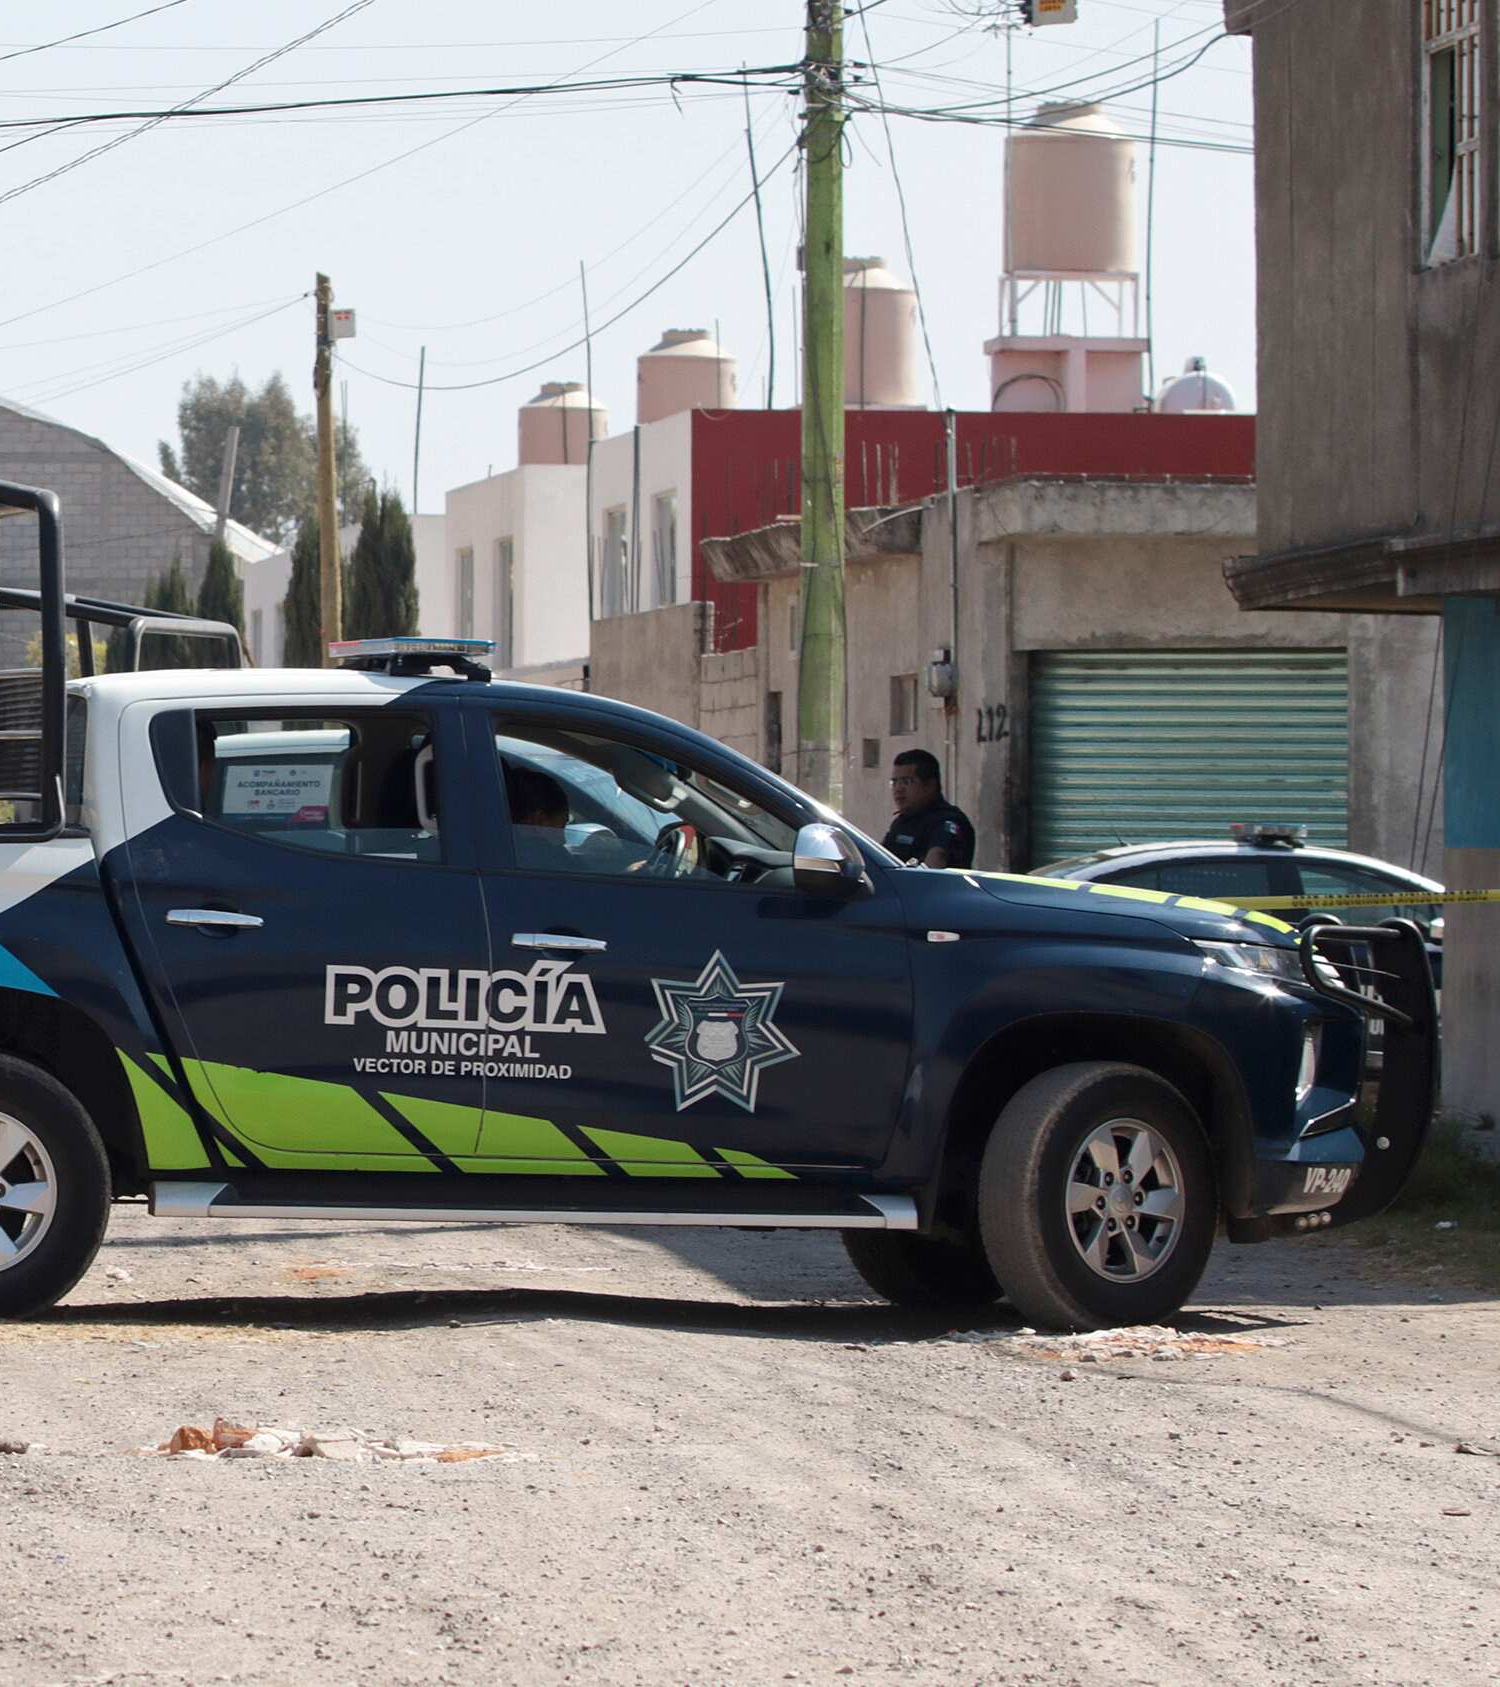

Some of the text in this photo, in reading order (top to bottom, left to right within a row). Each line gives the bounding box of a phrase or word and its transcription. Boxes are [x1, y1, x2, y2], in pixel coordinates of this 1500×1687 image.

[237, 778, 321, 788] ACOMPAÑAMIENTO
[254, 788, 301, 796] BANCARIO
[324, 959, 607, 1035] POLICÍA
[385, 1030, 540, 1058] MUNICIPAL
[353, 1057, 572, 1080] VECTOR DE PROXIMIDAD
[1303, 1167, 1352, 1193] VP-240
